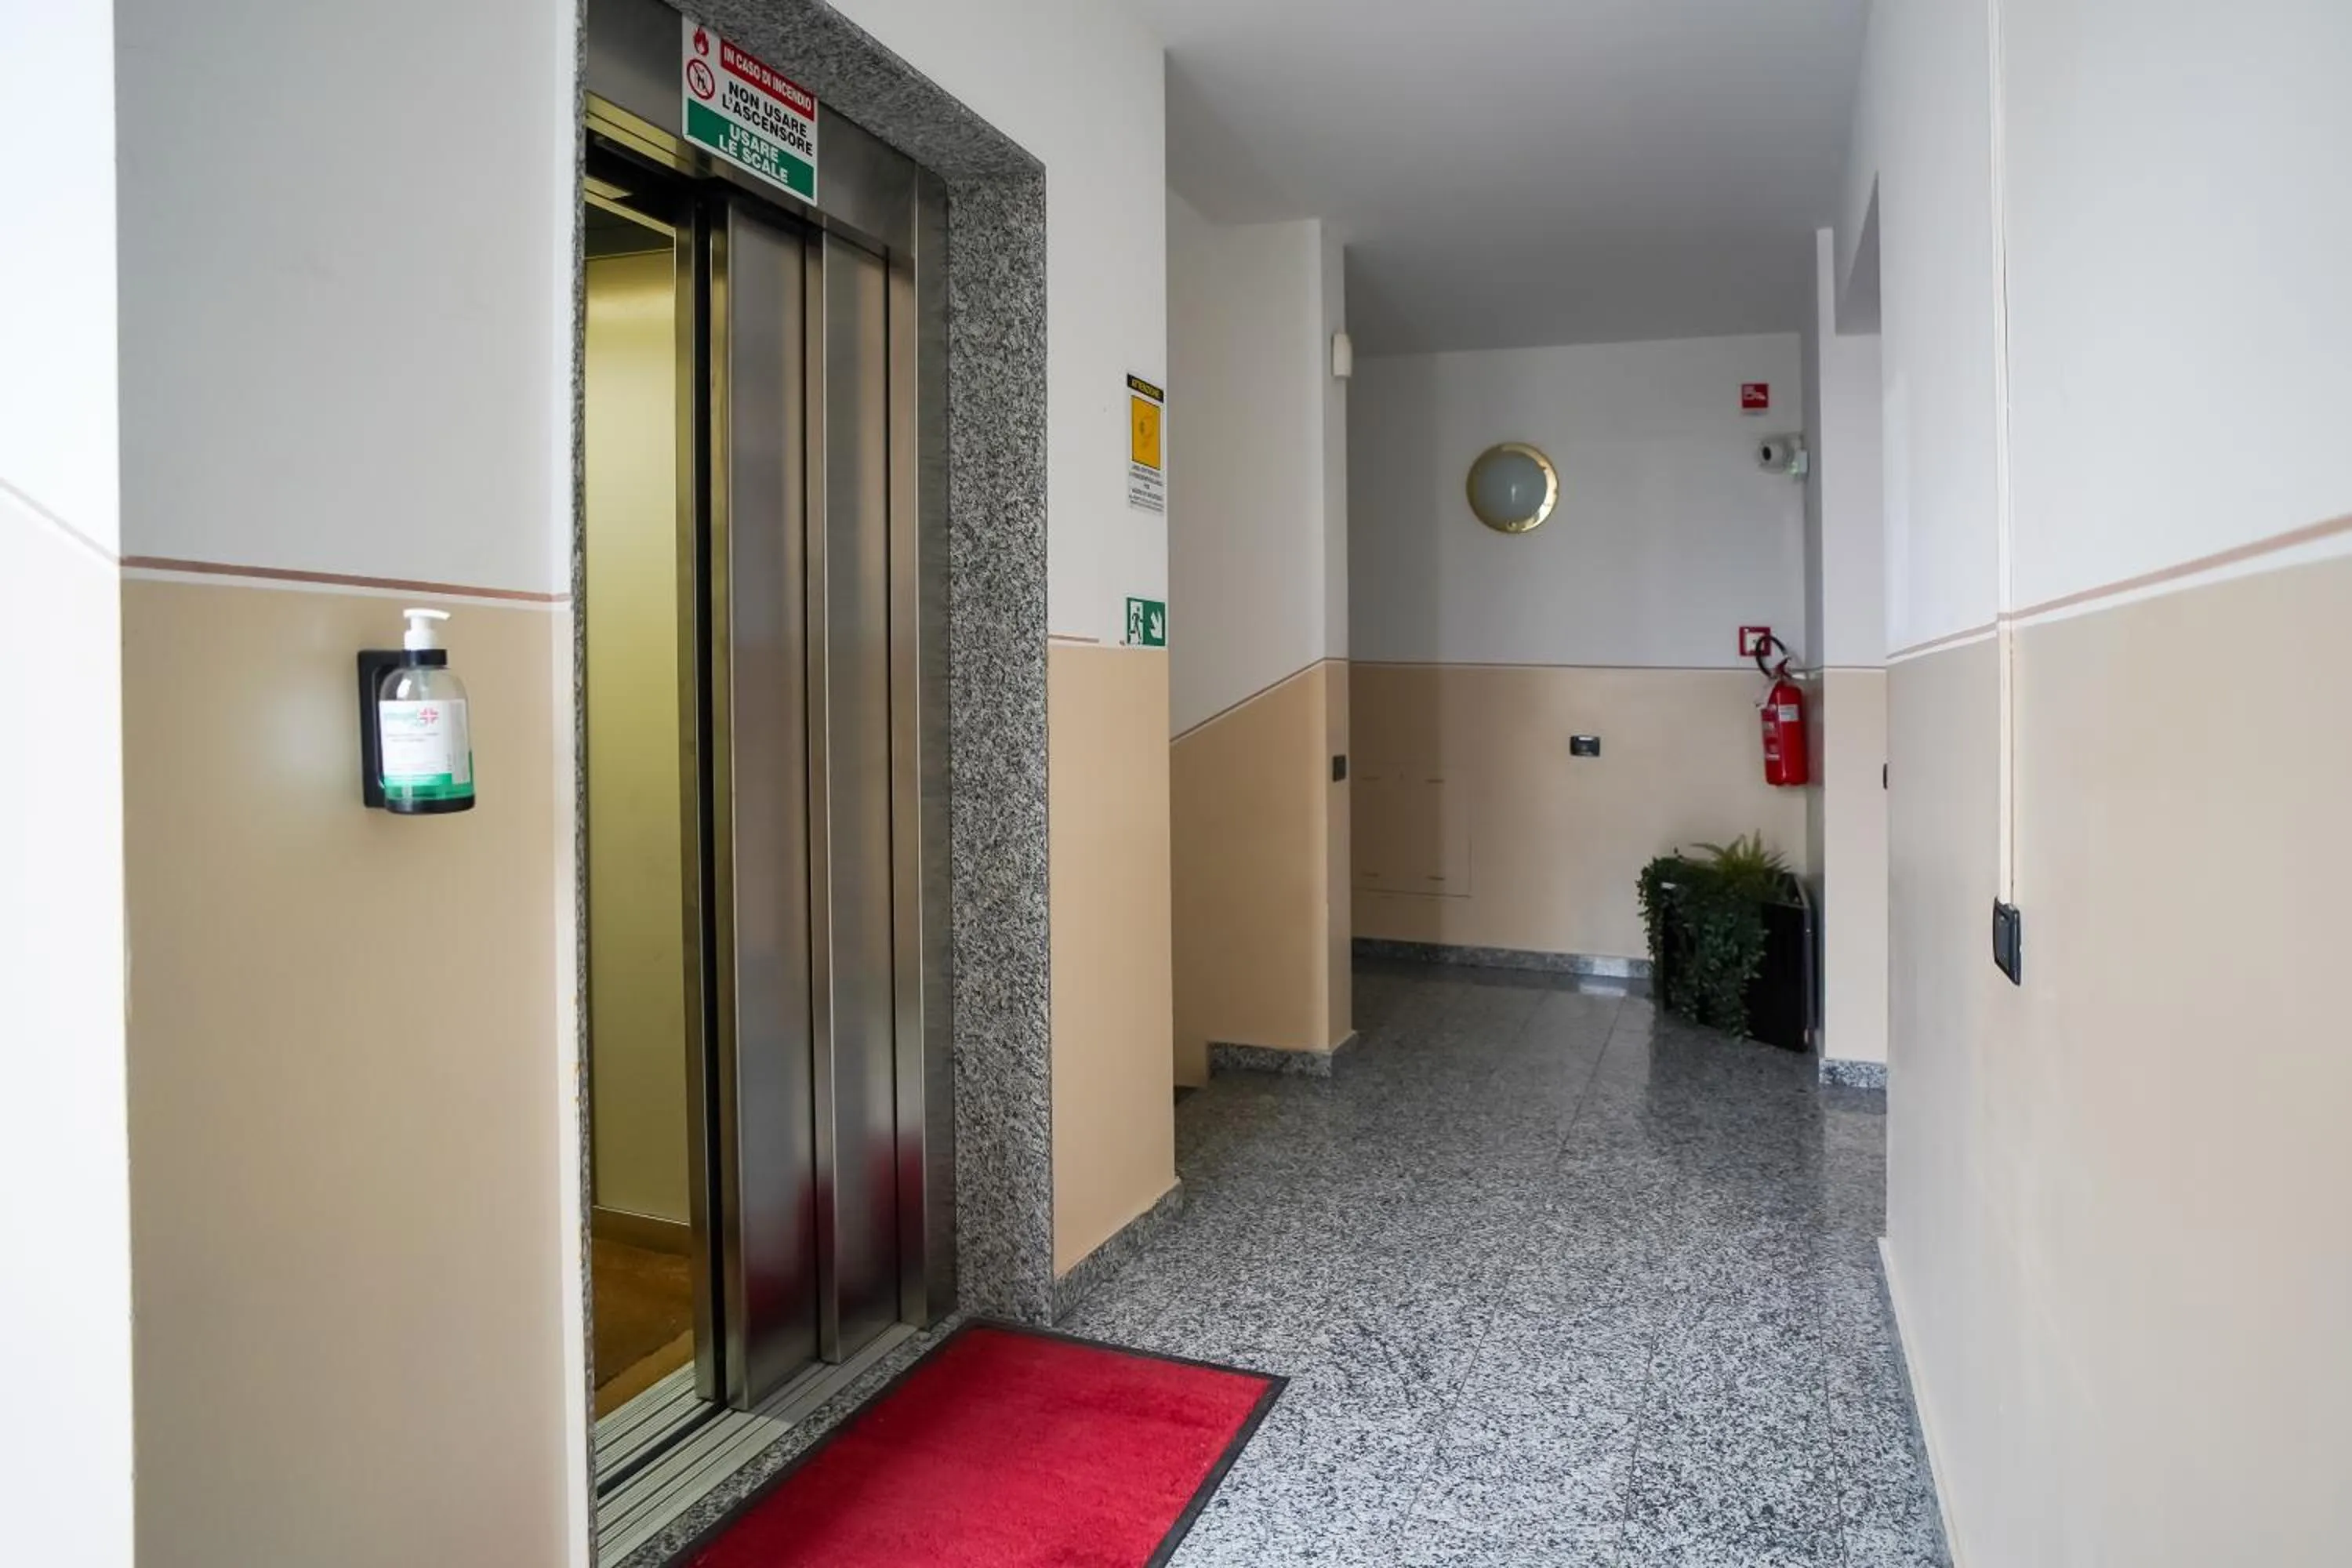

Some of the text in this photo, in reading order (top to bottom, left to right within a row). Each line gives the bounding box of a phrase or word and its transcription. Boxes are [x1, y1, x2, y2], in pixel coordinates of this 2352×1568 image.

[724, 45, 812, 111] IN CASO DI INCENDIO
[723, 94, 813, 157] L'ASCENSORE
[729, 82, 807, 138] NON USARE
[719, 134, 788, 183] LE SCALE
[730, 124, 779, 162] USARE
